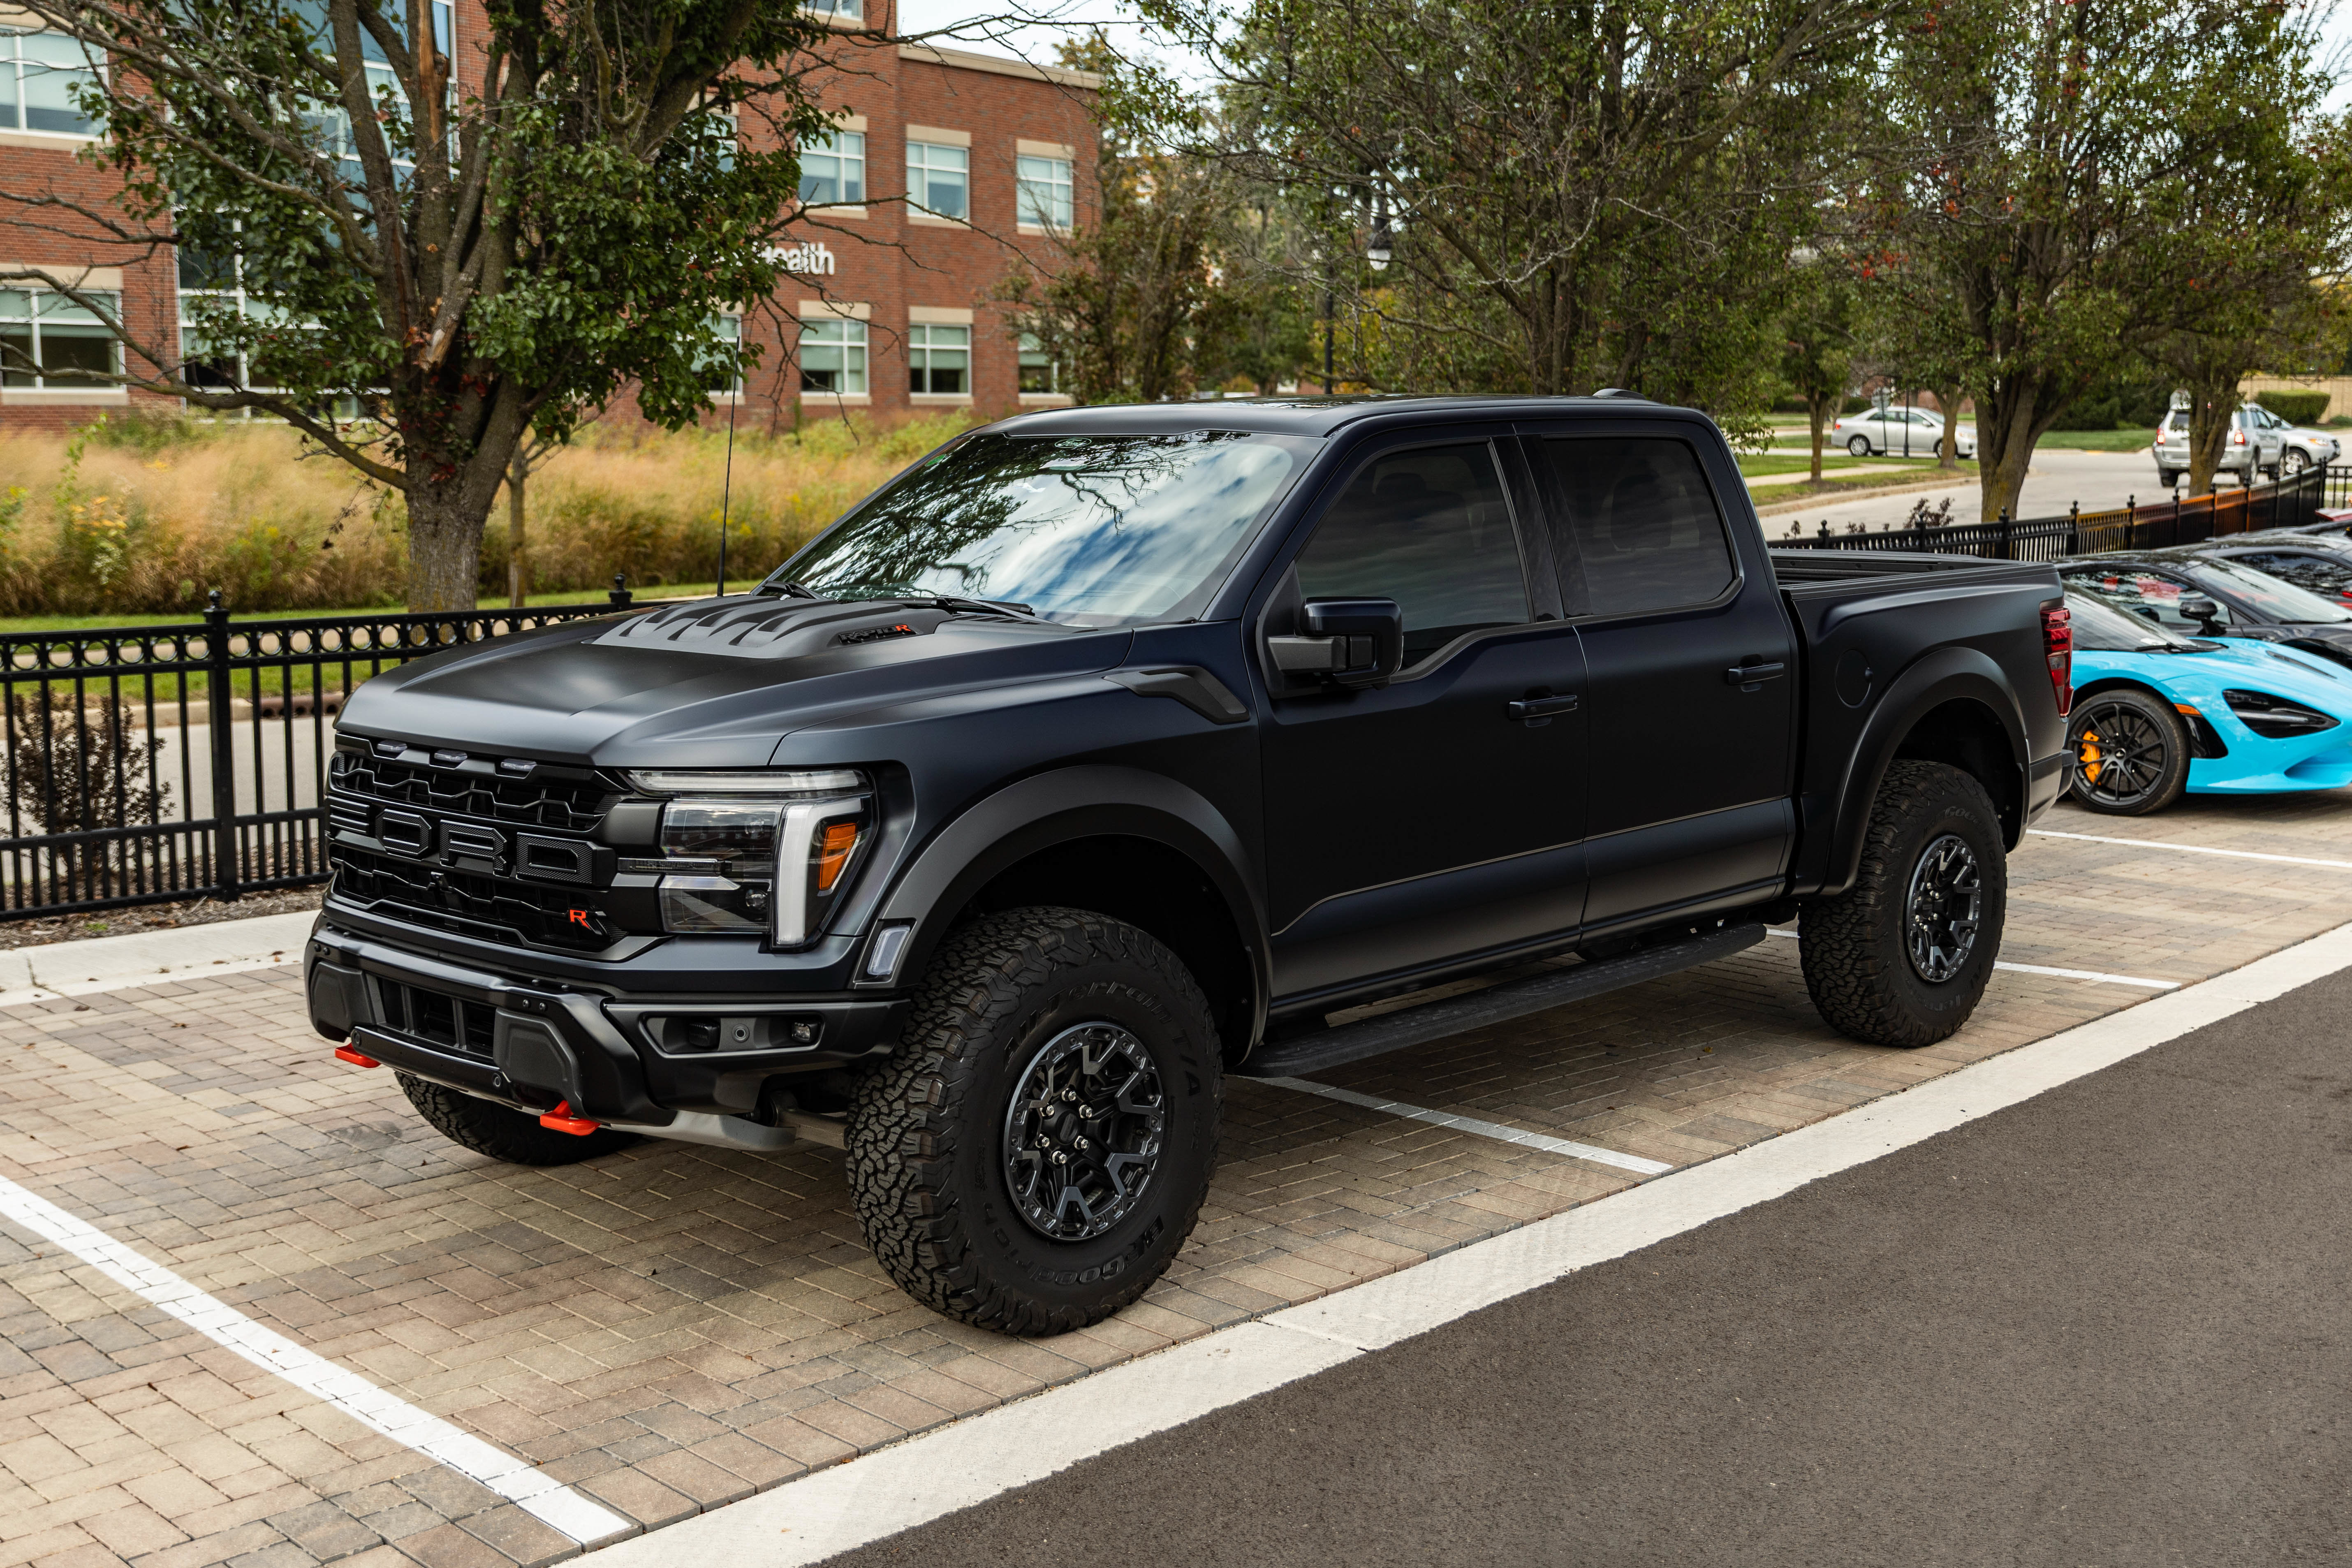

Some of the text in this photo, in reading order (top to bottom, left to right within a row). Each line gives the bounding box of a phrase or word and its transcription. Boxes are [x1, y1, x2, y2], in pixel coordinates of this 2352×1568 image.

[839, 624, 912, 643] RAPTOR
[329, 795, 598, 885] FORD
[569, 909, 592, 931] R
[983, 1202, 1164, 1286] BFGoodrich
